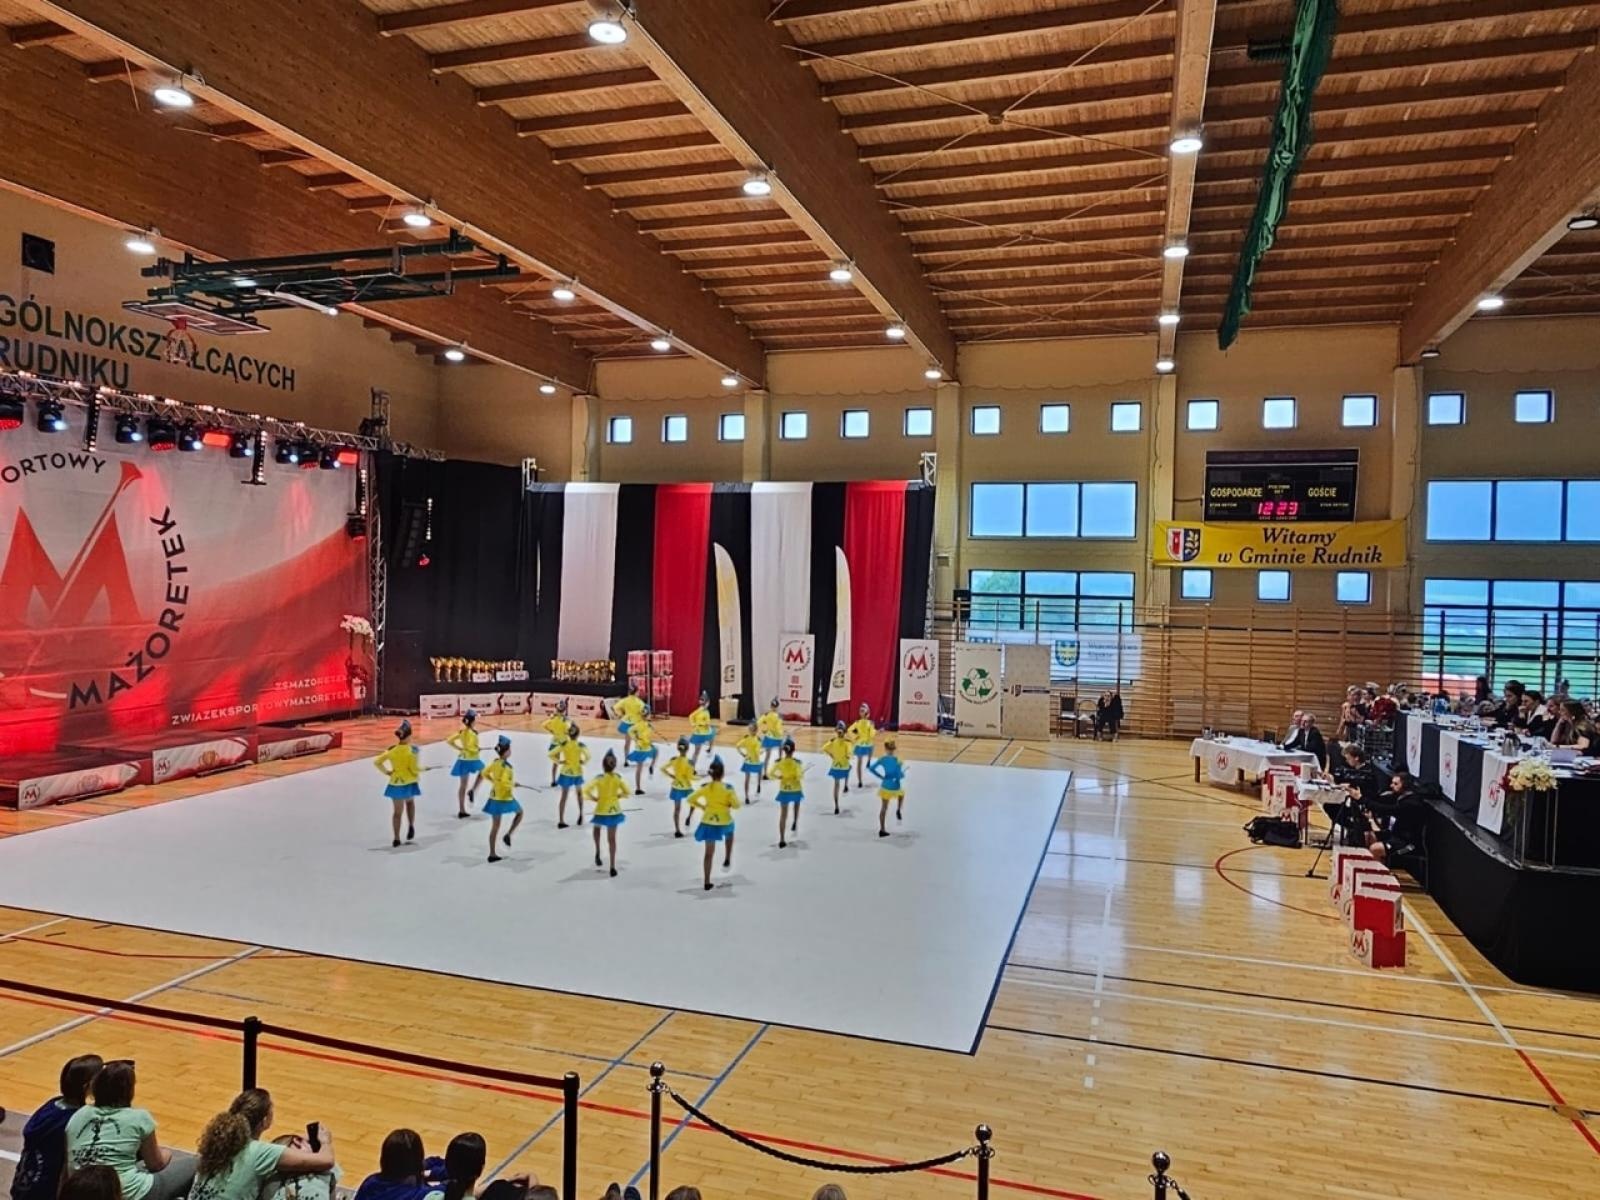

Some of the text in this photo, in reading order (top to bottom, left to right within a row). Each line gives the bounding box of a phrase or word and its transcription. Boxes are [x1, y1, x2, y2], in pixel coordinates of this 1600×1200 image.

[0, 335, 129, 389] RUDNIKU
[1, 453, 106, 483] ORTOWY
[1210, 487, 1263, 498] GOSPODARZE
[1308, 485, 1337, 498] GOŚCIE
[1262, 527, 1336, 546] Witamy
[1217, 545, 1383, 564] w Gminie Rudnik
[69, 506, 189, 709] MAŻORETEK
